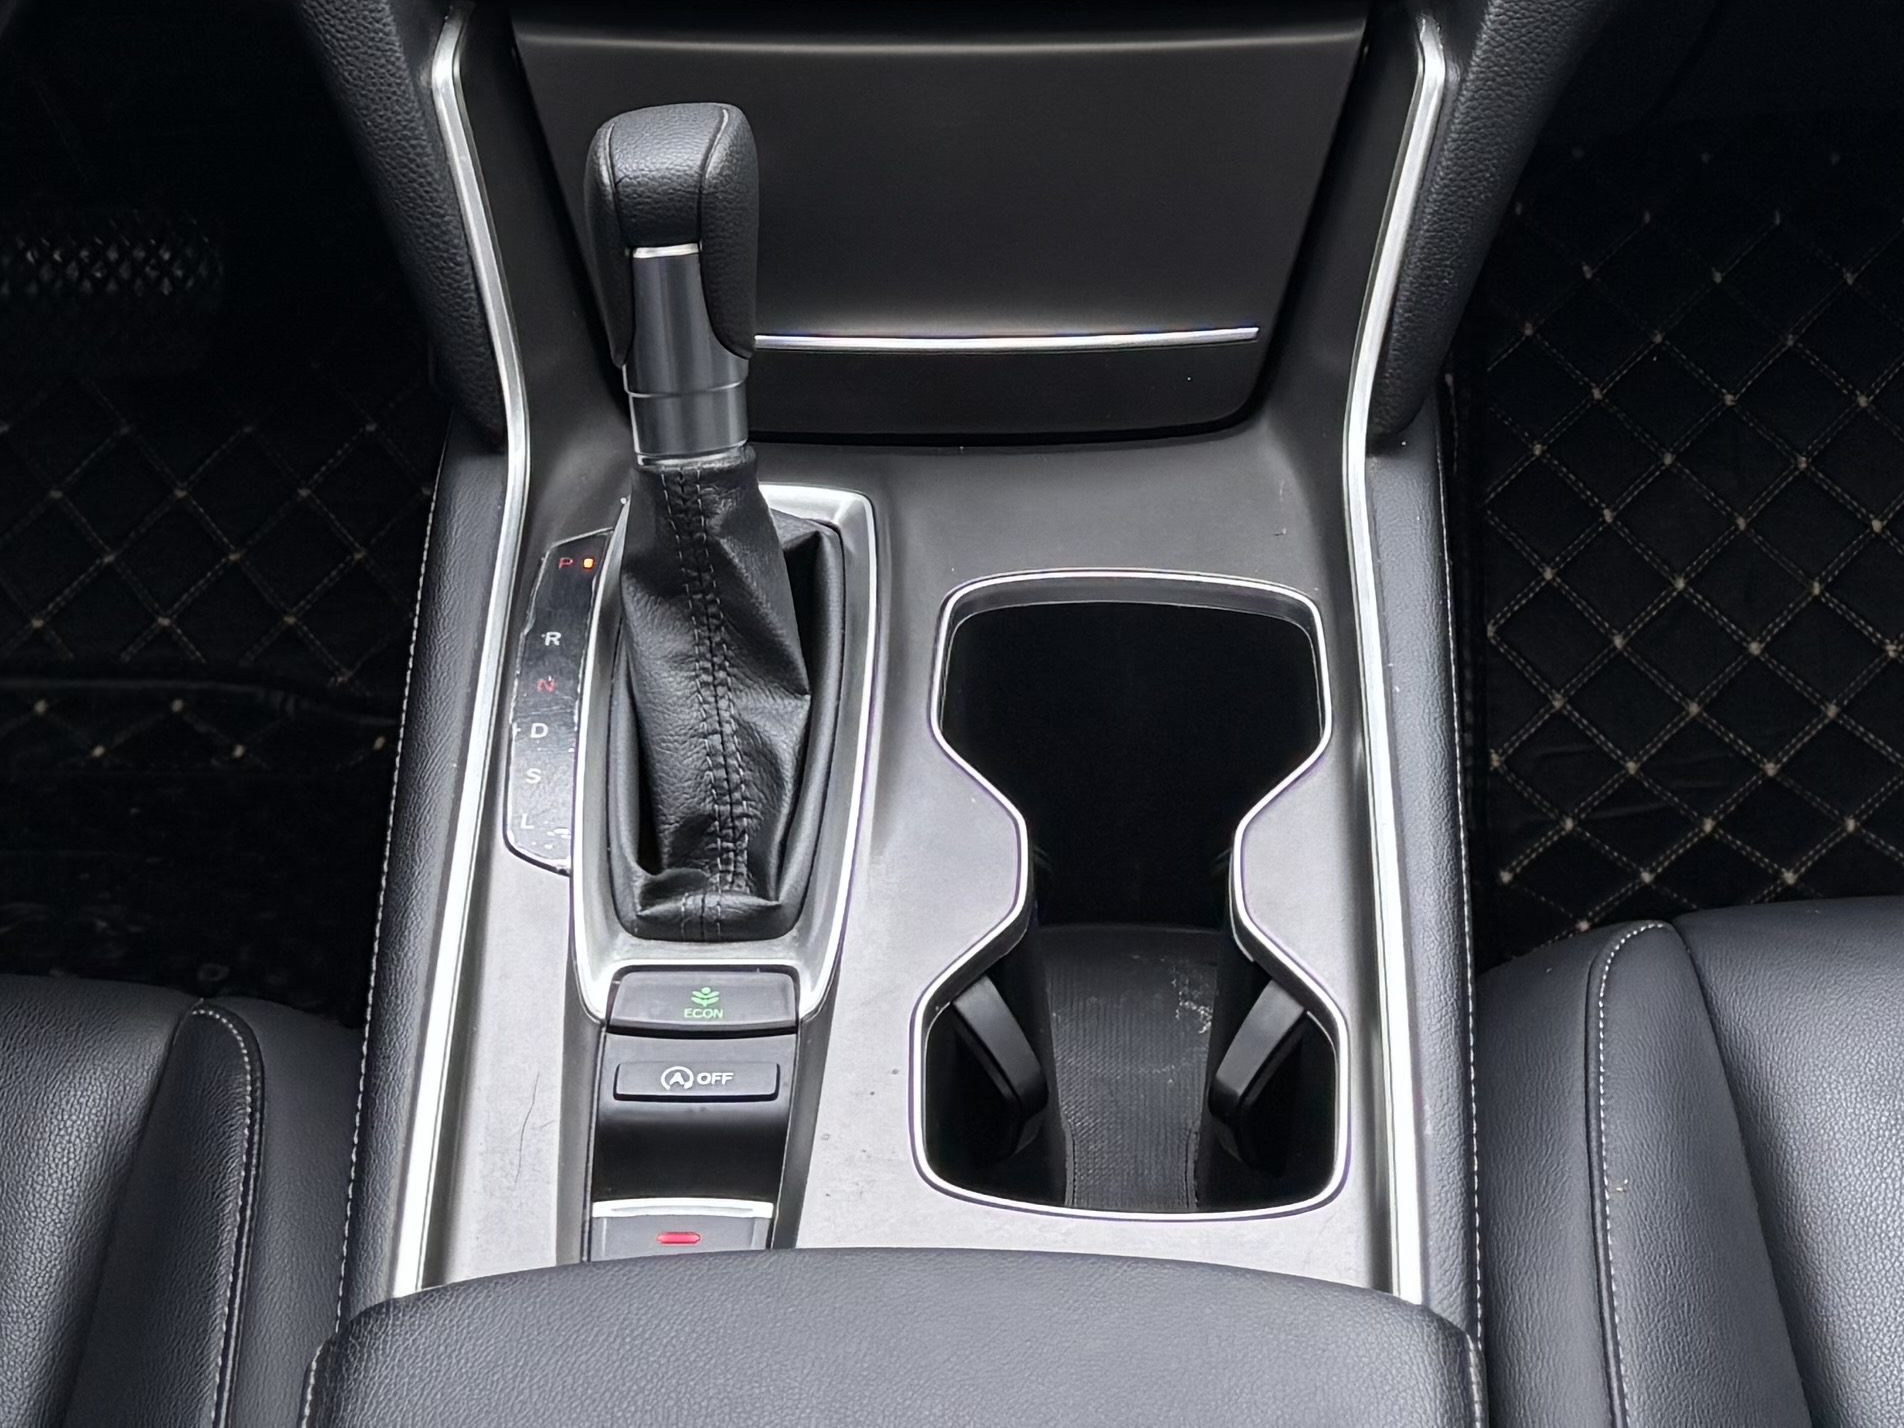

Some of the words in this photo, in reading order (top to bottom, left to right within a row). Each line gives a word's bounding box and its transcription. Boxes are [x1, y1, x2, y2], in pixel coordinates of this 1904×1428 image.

[558, 557, 574, 569] P
[544, 632, 562, 646] R
[537, 678, 557, 693] N
[530, 722, 549, 739] D
[525, 767, 542, 784] S
[519, 813, 535, 830] L
[683, 1007, 724, 1019] ECON
[697, 1072, 734, 1085] OFF
